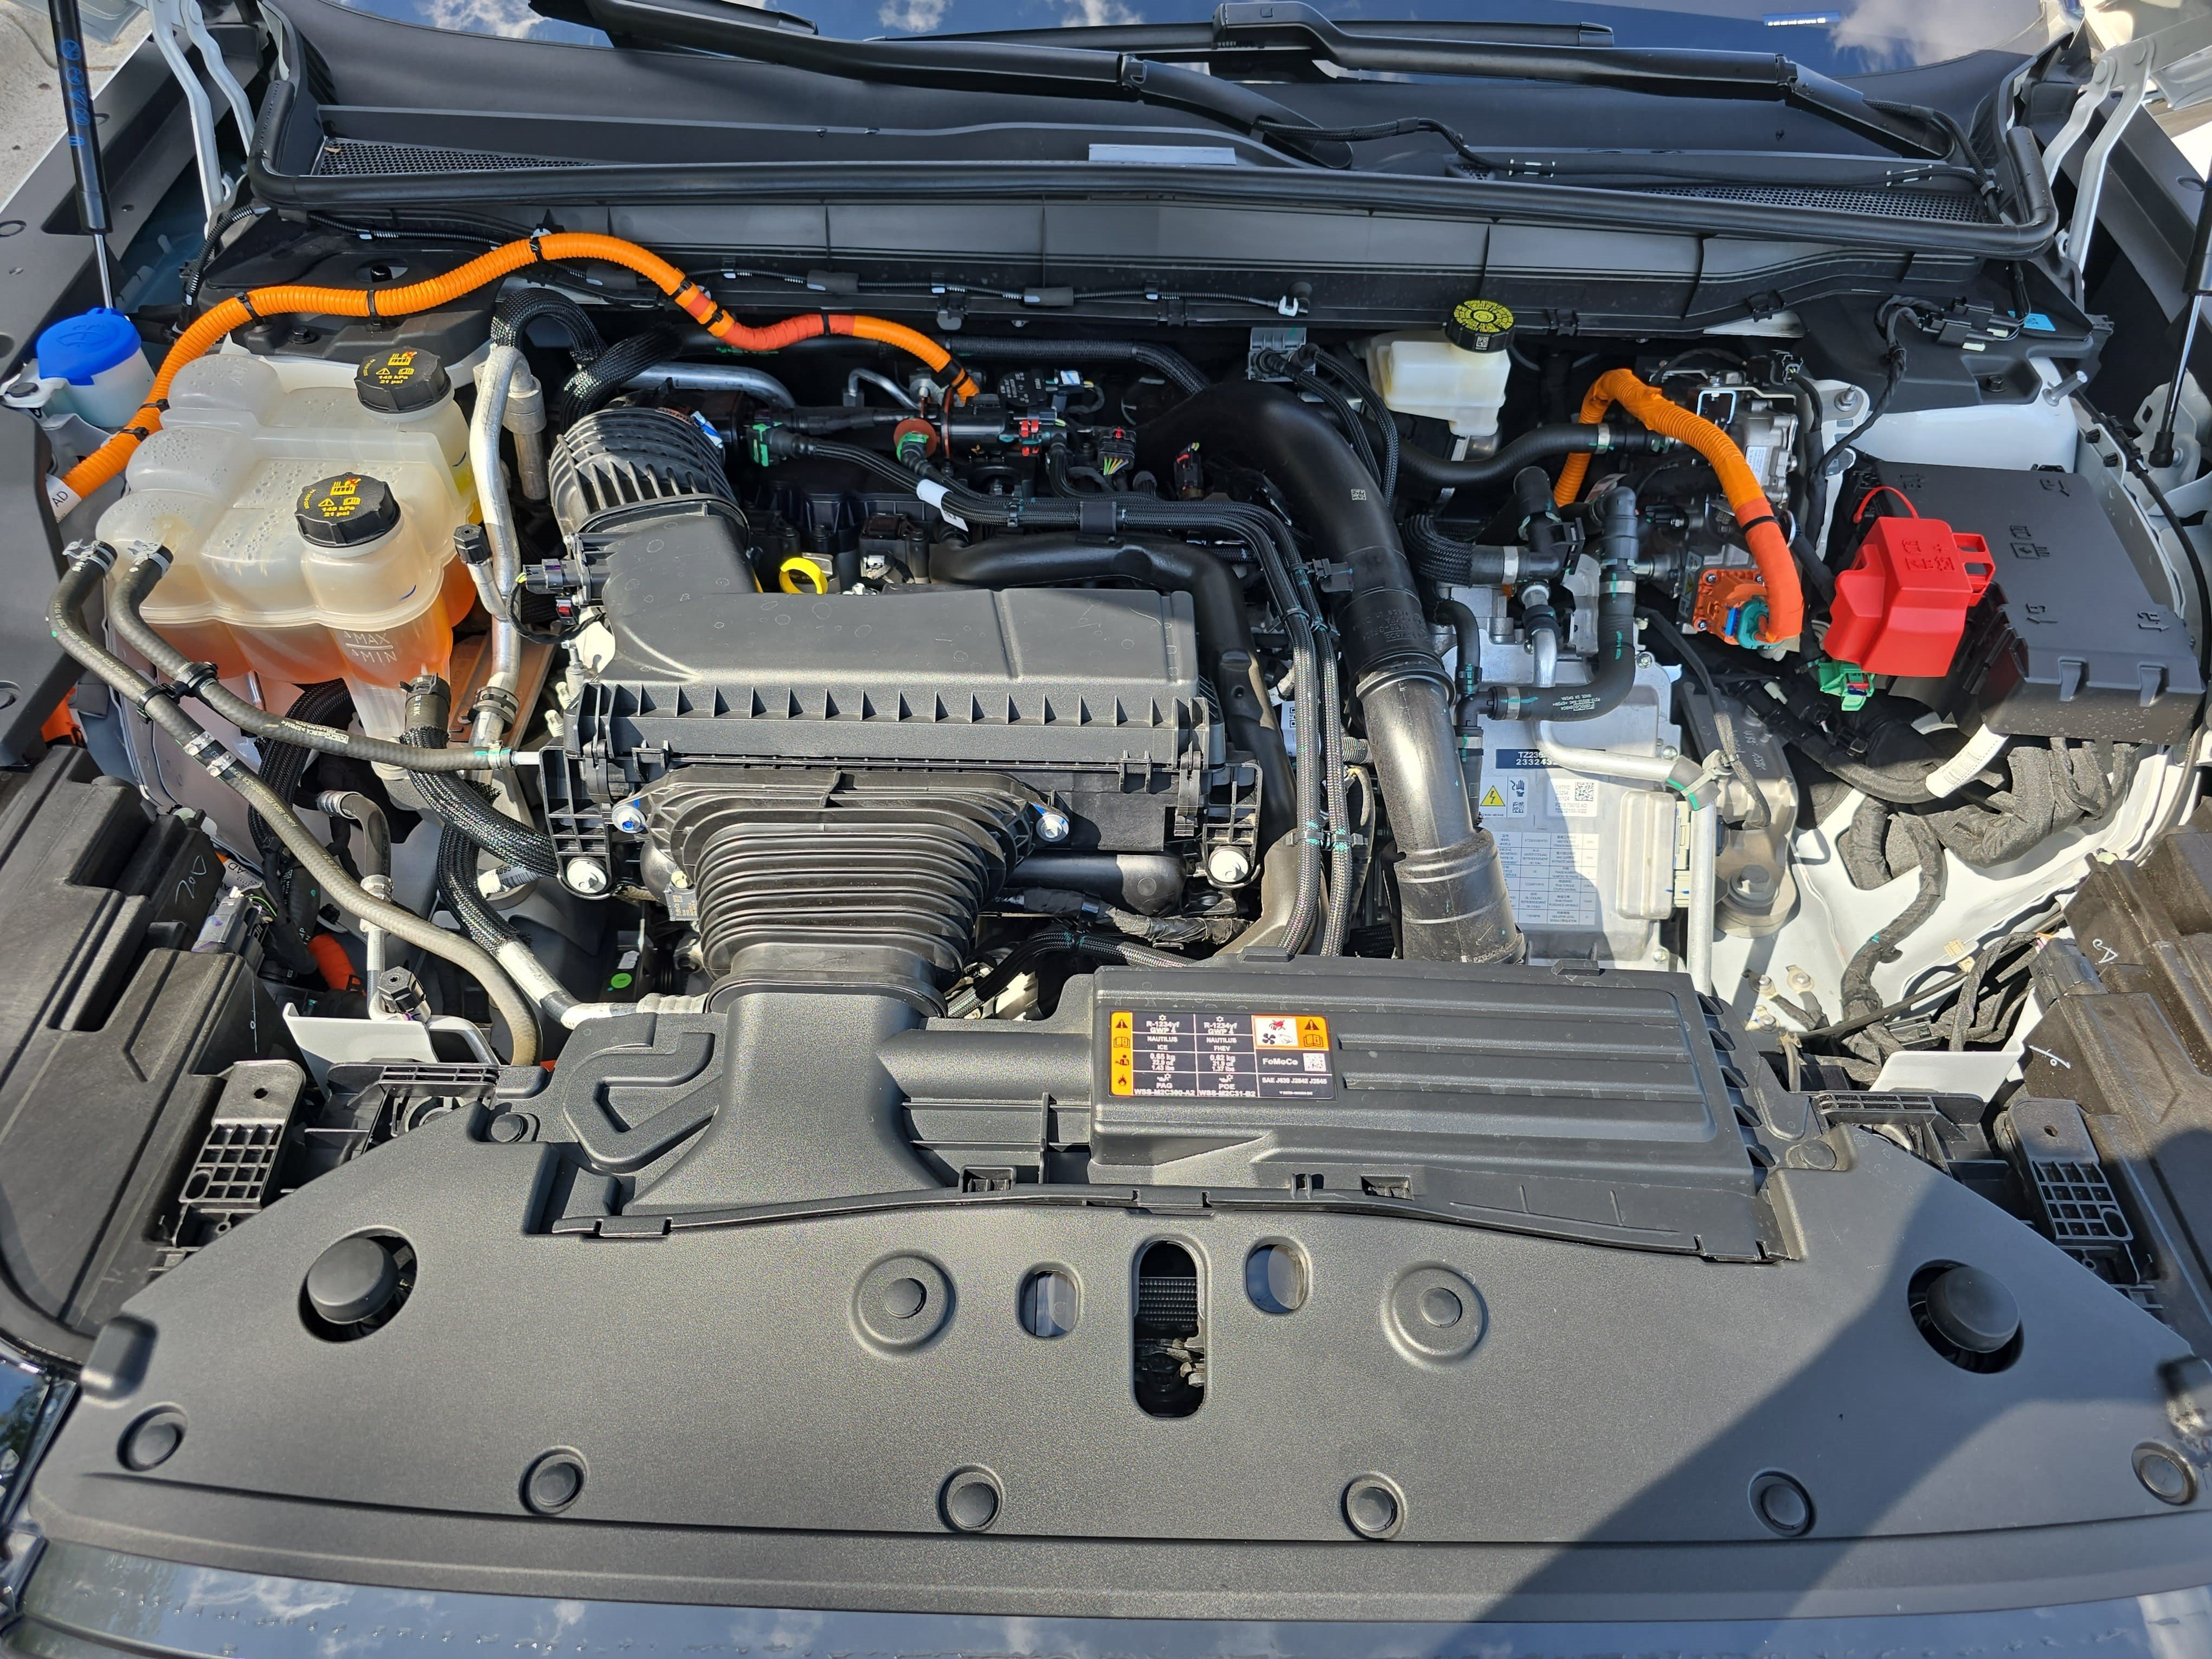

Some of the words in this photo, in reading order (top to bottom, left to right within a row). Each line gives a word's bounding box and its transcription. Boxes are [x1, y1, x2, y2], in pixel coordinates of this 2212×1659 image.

[52, 491, 68, 507] AD
[353, 633, 391, 645] MAX
[360, 651, 397, 664] MIN
[228, 863, 246, 874] AD
